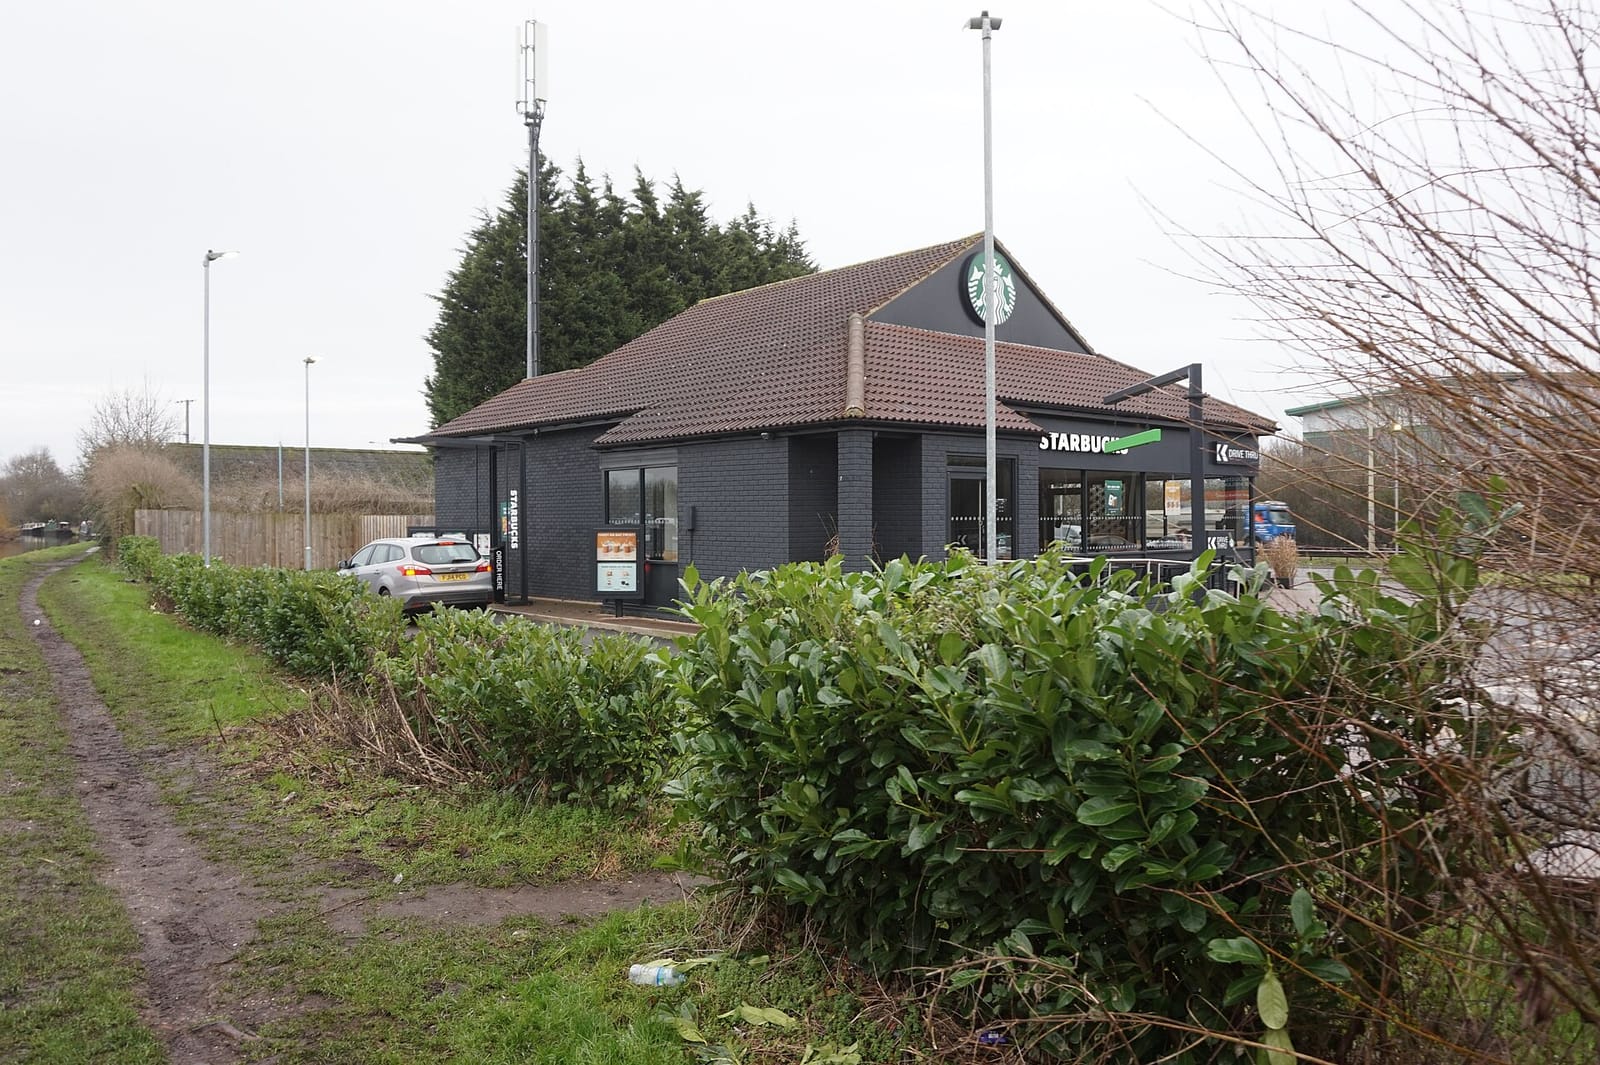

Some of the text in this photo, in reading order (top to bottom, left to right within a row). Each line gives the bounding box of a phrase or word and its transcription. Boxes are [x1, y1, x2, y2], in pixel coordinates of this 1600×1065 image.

[1039, 432, 1129, 454] STARBUC
[1228, 449, 1259, 460] DRIVE THRU
[510, 489, 519, 549] STARBUCKS
